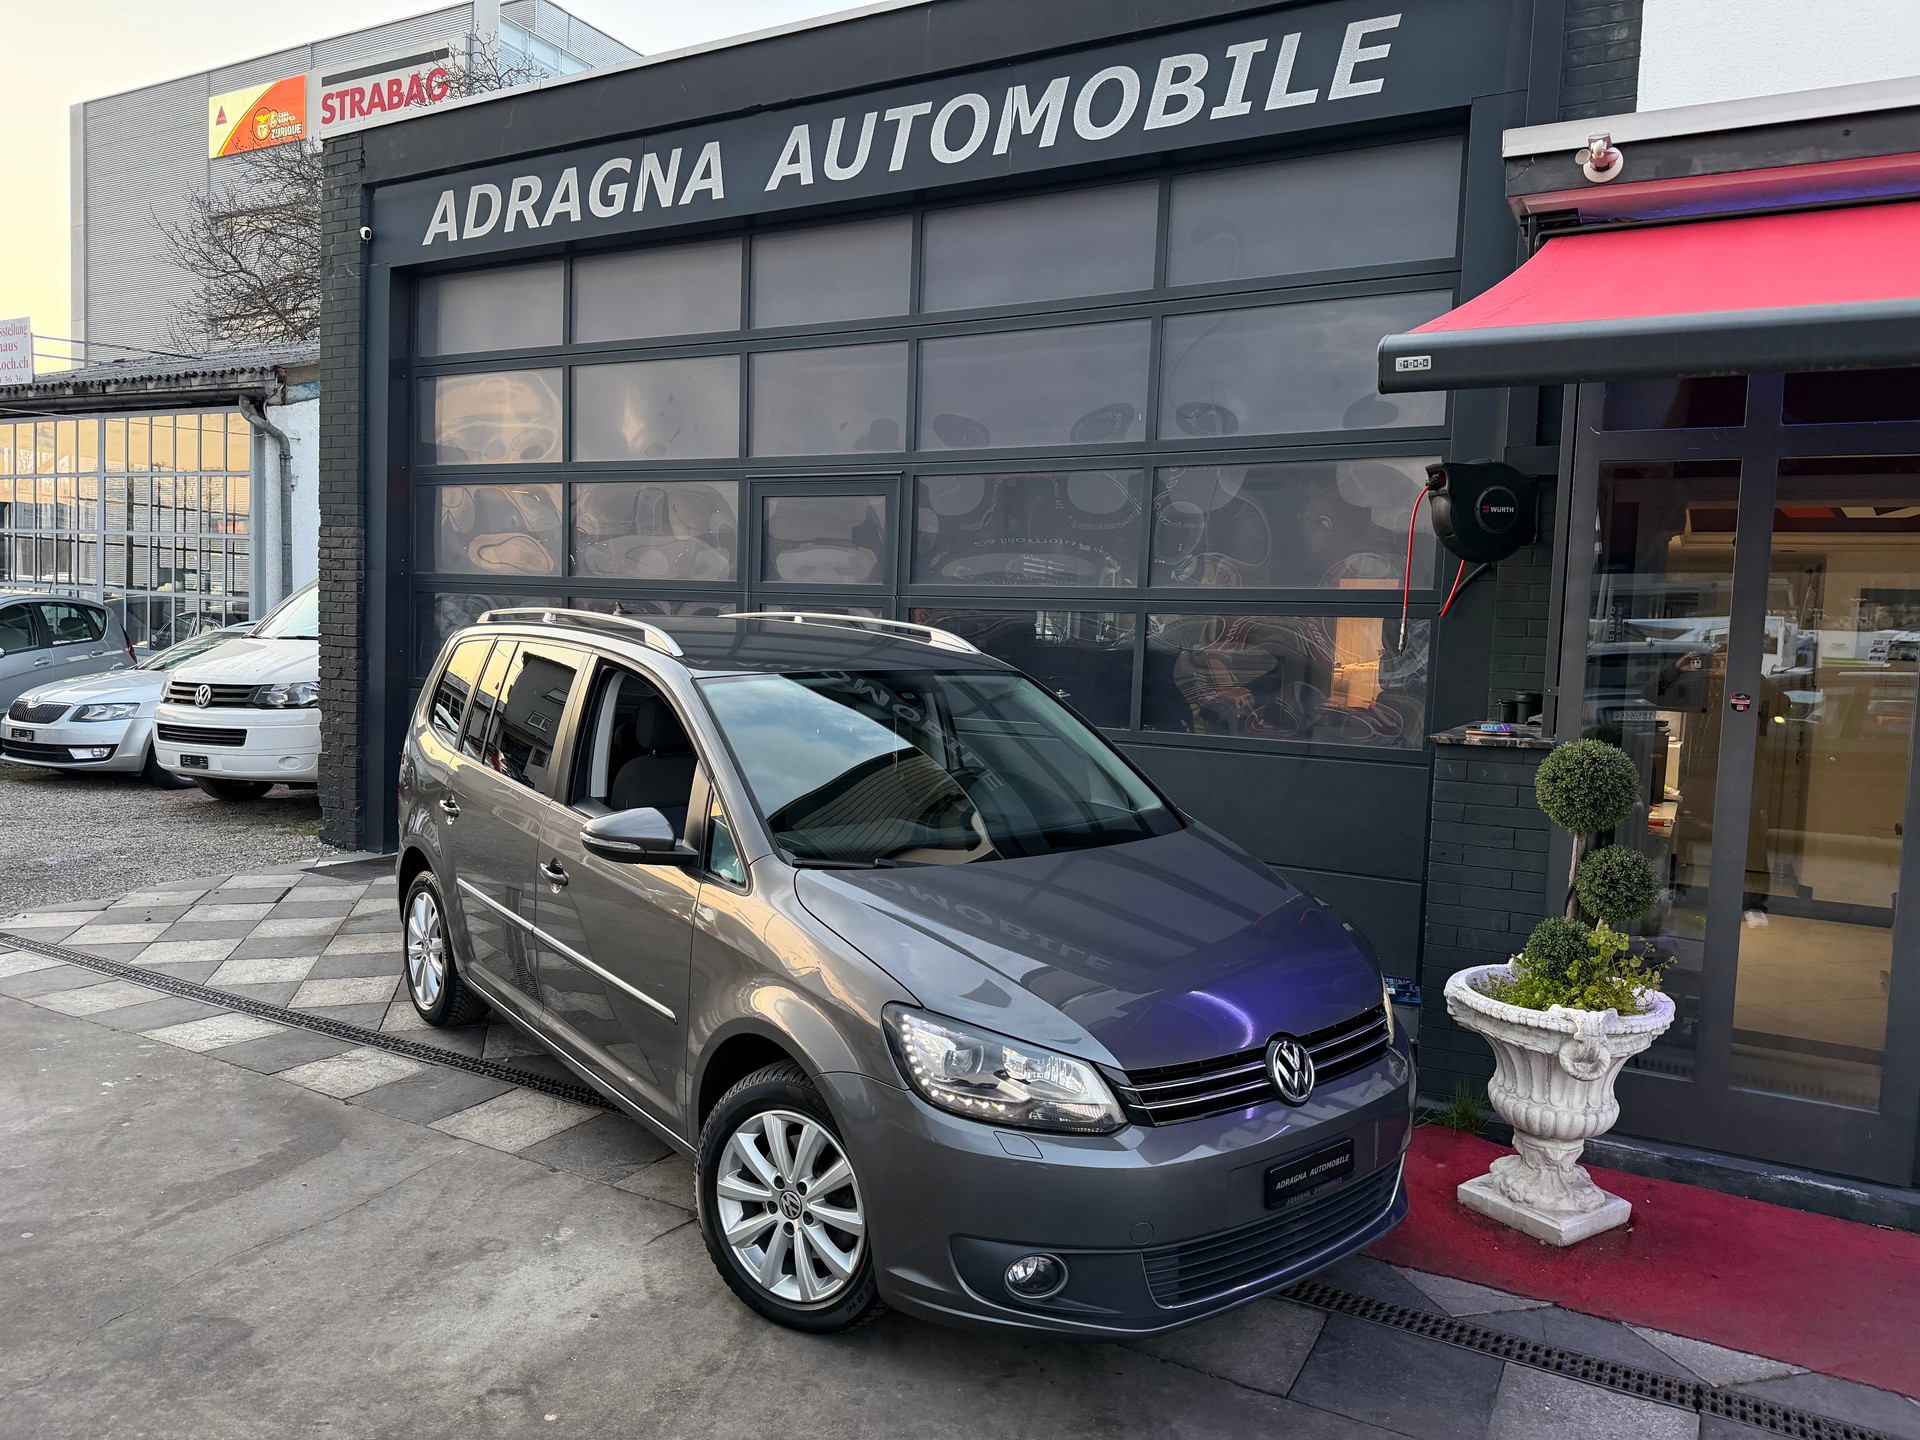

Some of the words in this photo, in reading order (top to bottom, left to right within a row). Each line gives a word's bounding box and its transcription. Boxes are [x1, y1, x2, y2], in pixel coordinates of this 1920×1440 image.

[321, 67, 450, 125] STRABAG
[271, 123, 303, 139] ZURIQUE
[421, 141, 725, 246] ADRAGNA
[764, 13, 1403, 192] AUTOMOBILE
[1398, 358, 1429, 369] STOBAG
[15, 374, 24, 383] 36
[1275, 1171, 1307, 1191] ADRAGNA
[1309, 1153, 1350, 1177] AUTOMOBILE
